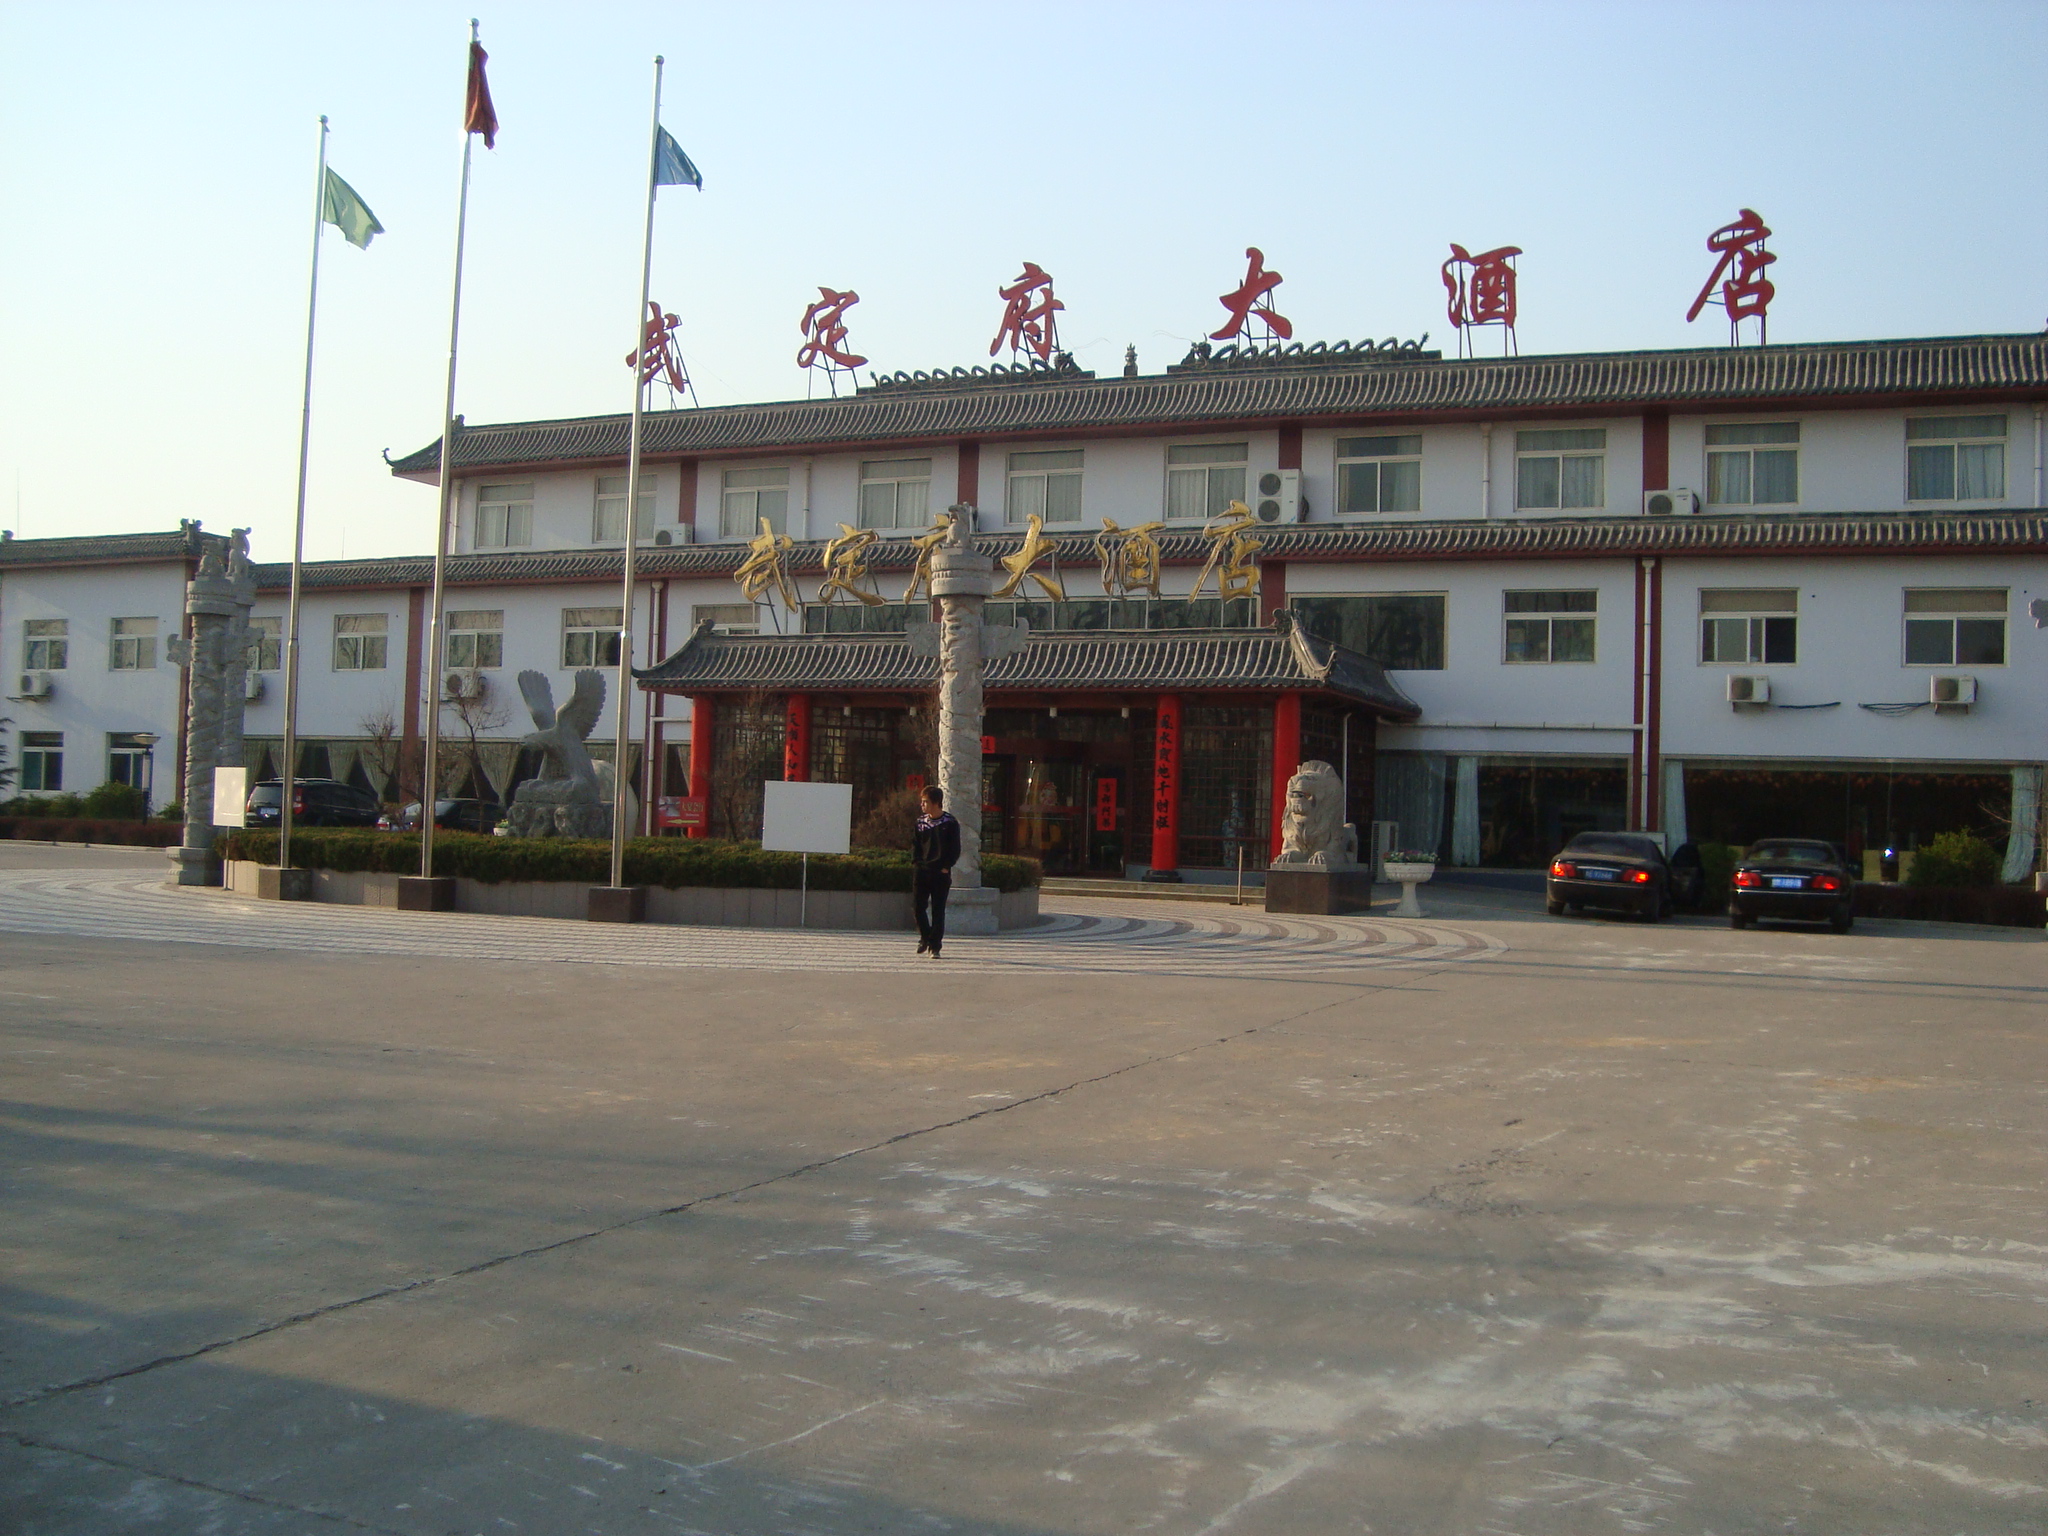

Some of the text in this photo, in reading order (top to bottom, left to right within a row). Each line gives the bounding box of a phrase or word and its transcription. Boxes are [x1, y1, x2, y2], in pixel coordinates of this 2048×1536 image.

[625, 208, 1777, 394] 武定府大酒店
